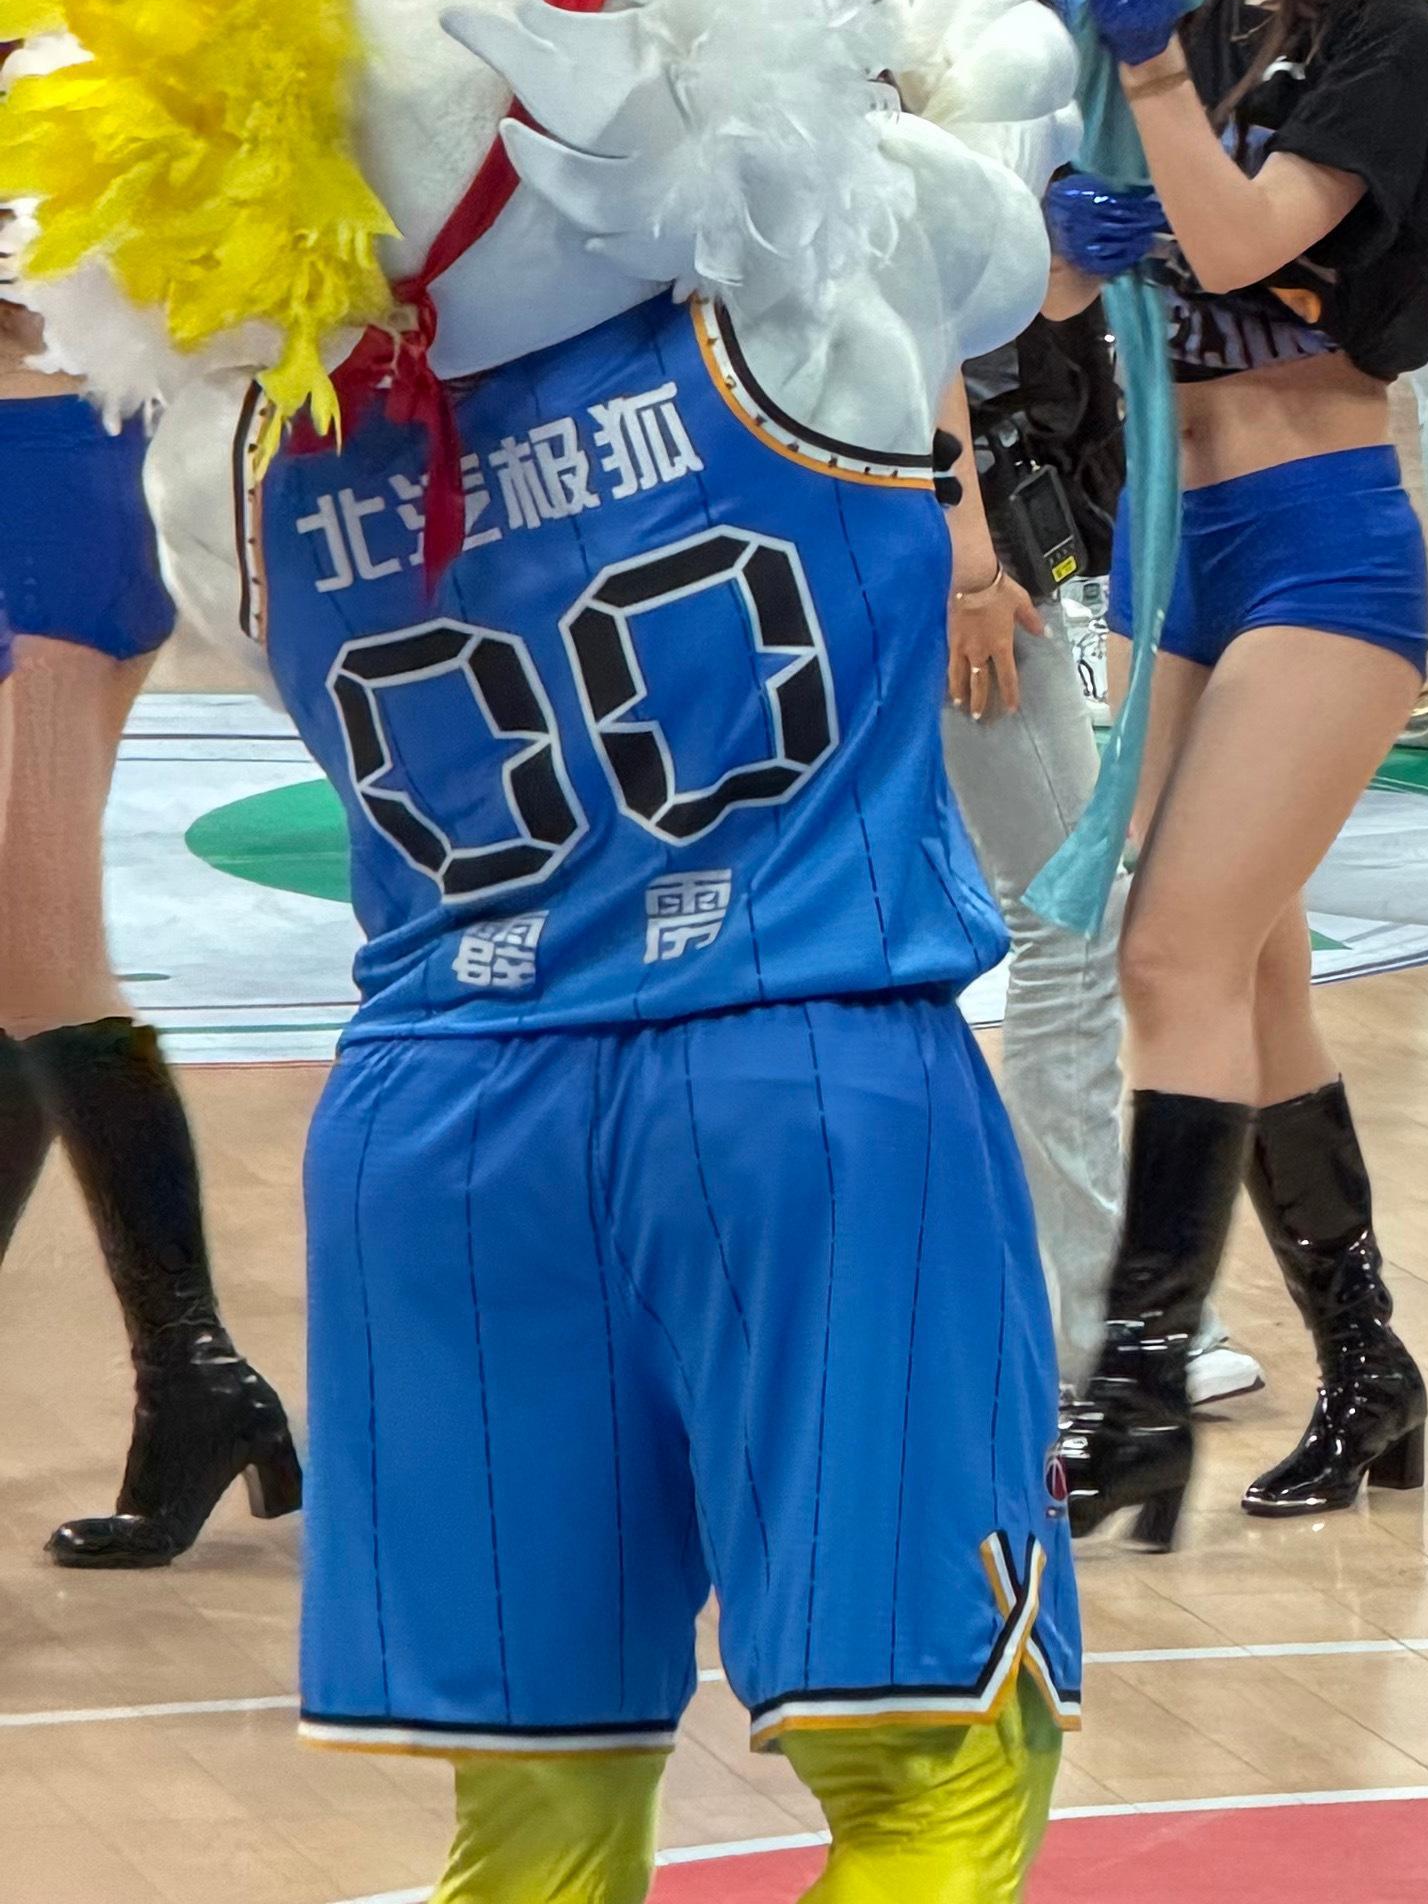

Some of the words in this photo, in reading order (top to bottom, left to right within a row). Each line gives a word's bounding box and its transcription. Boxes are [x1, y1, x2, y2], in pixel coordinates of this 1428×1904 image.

[295, 381, 704, 595] 北汽极狐
[324, 523, 840, 906] 00
